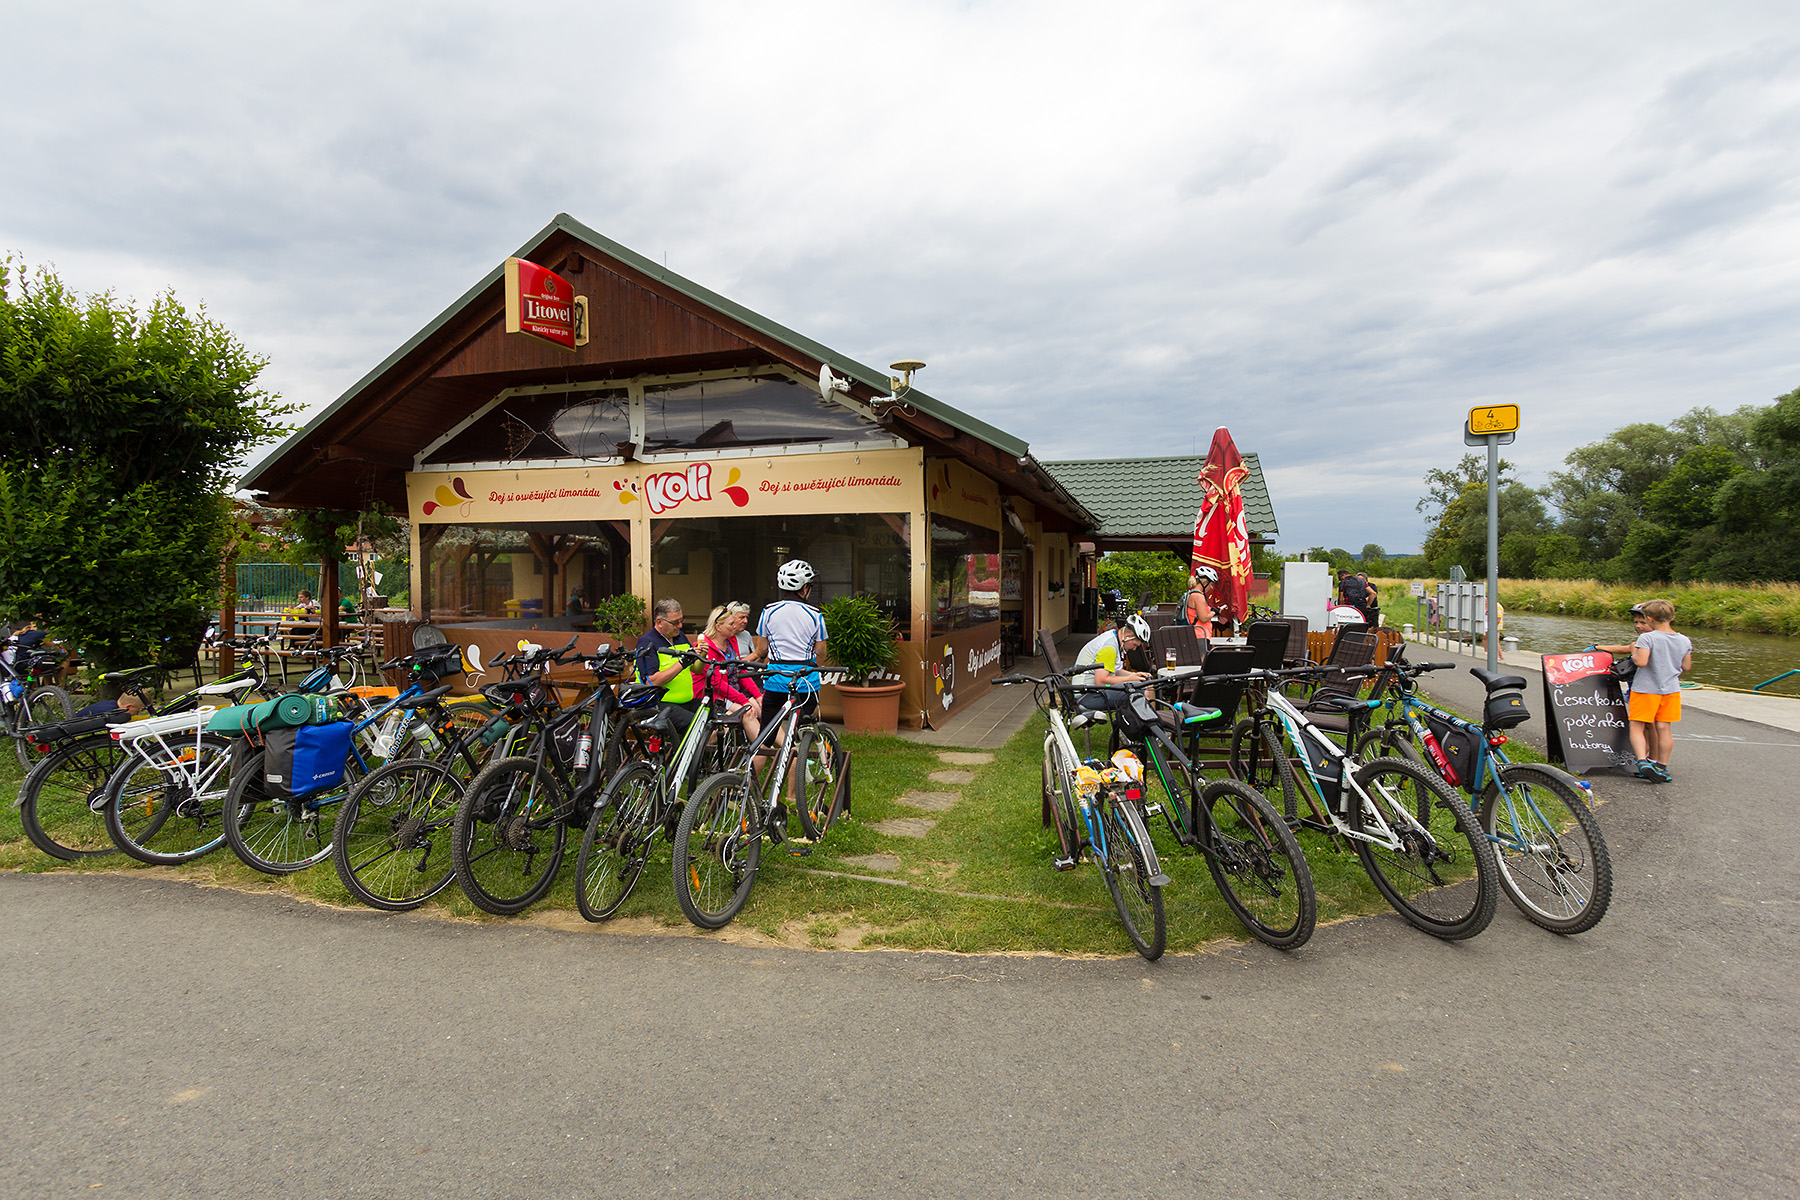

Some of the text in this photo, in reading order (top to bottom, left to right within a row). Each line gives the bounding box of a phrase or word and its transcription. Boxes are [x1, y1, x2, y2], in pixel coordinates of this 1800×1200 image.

[528, 300, 570, 322] Litovel
[1486, 409, 1494, 419] 4
[758, 475, 902, 496] Dej si osvěžující limonádu
[488, 487, 601, 506] Dej si osvěžující limonádu
[1585, 729, 1594, 739] s
